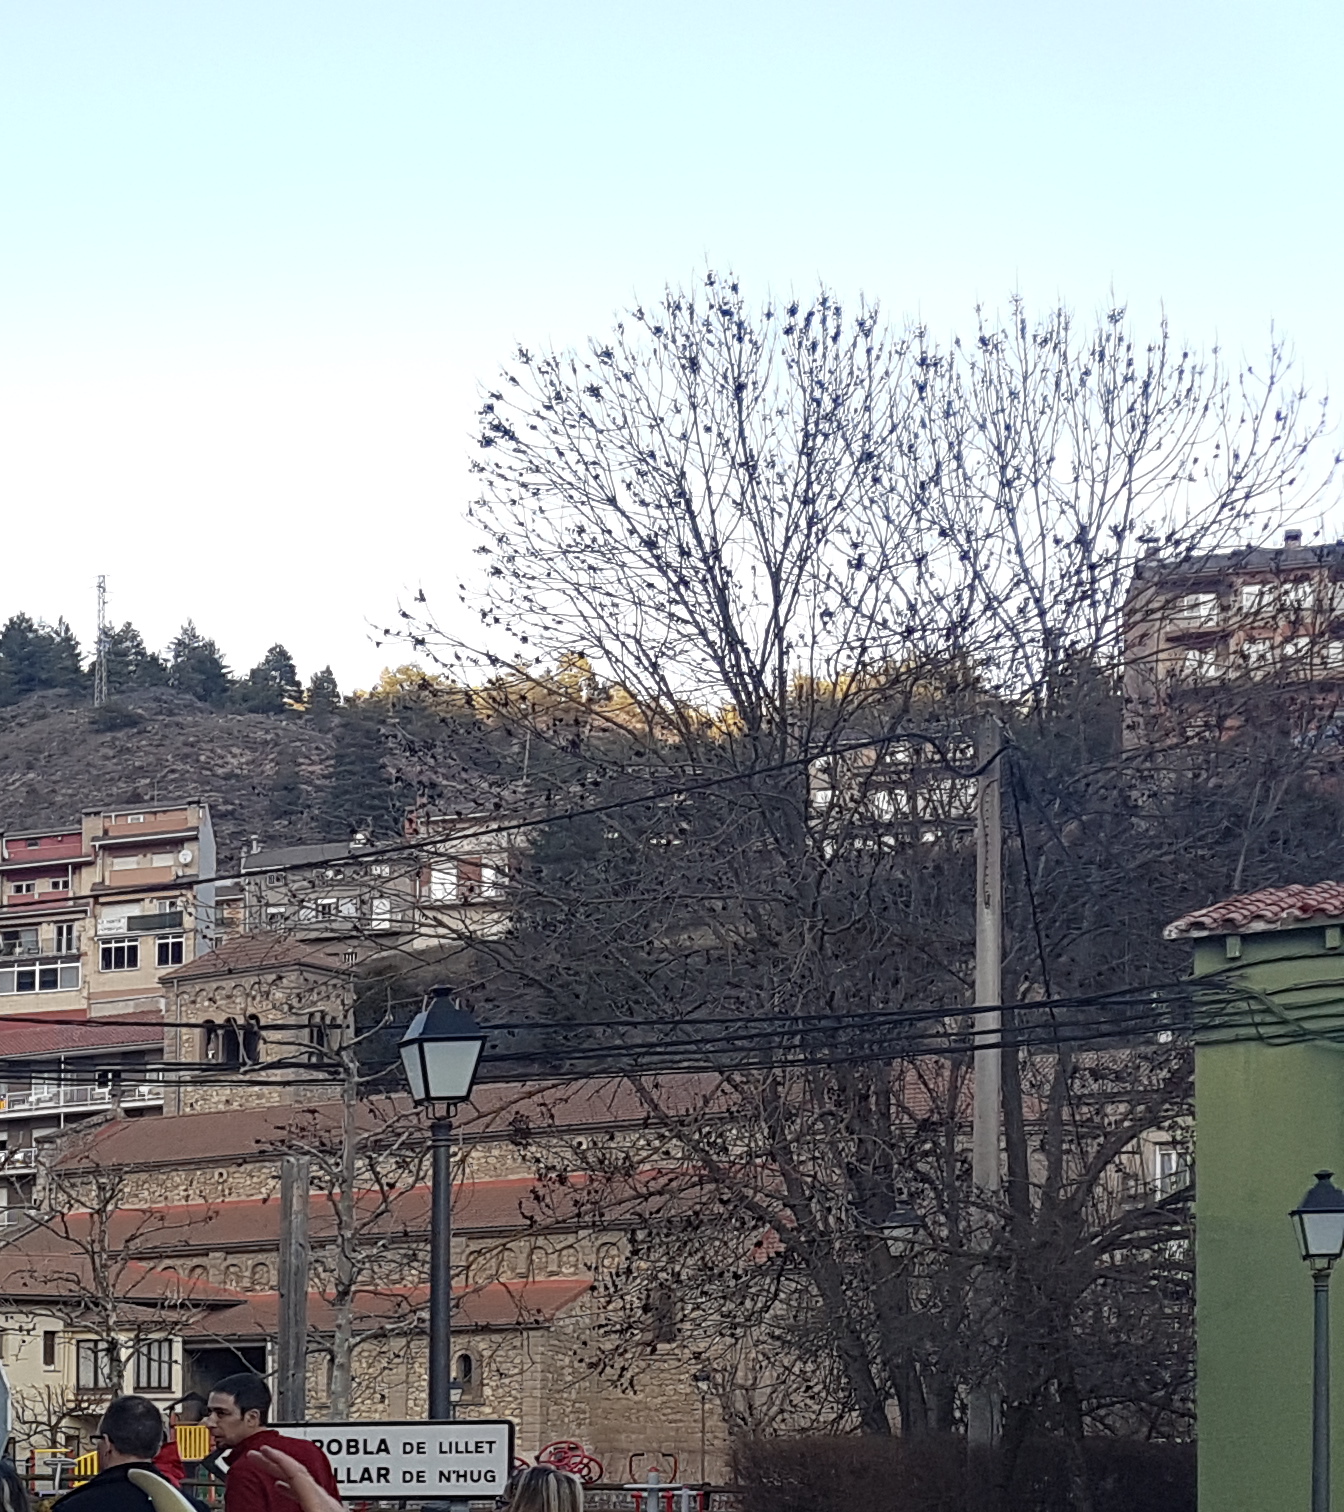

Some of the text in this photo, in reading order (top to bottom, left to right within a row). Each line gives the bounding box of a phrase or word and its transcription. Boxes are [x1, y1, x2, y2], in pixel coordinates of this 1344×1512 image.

[402, 1441, 427, 1455] DE
[438, 1440, 497, 1454] LILLET
[333, 1466, 497, 1484] LLAR DE N'HUG
